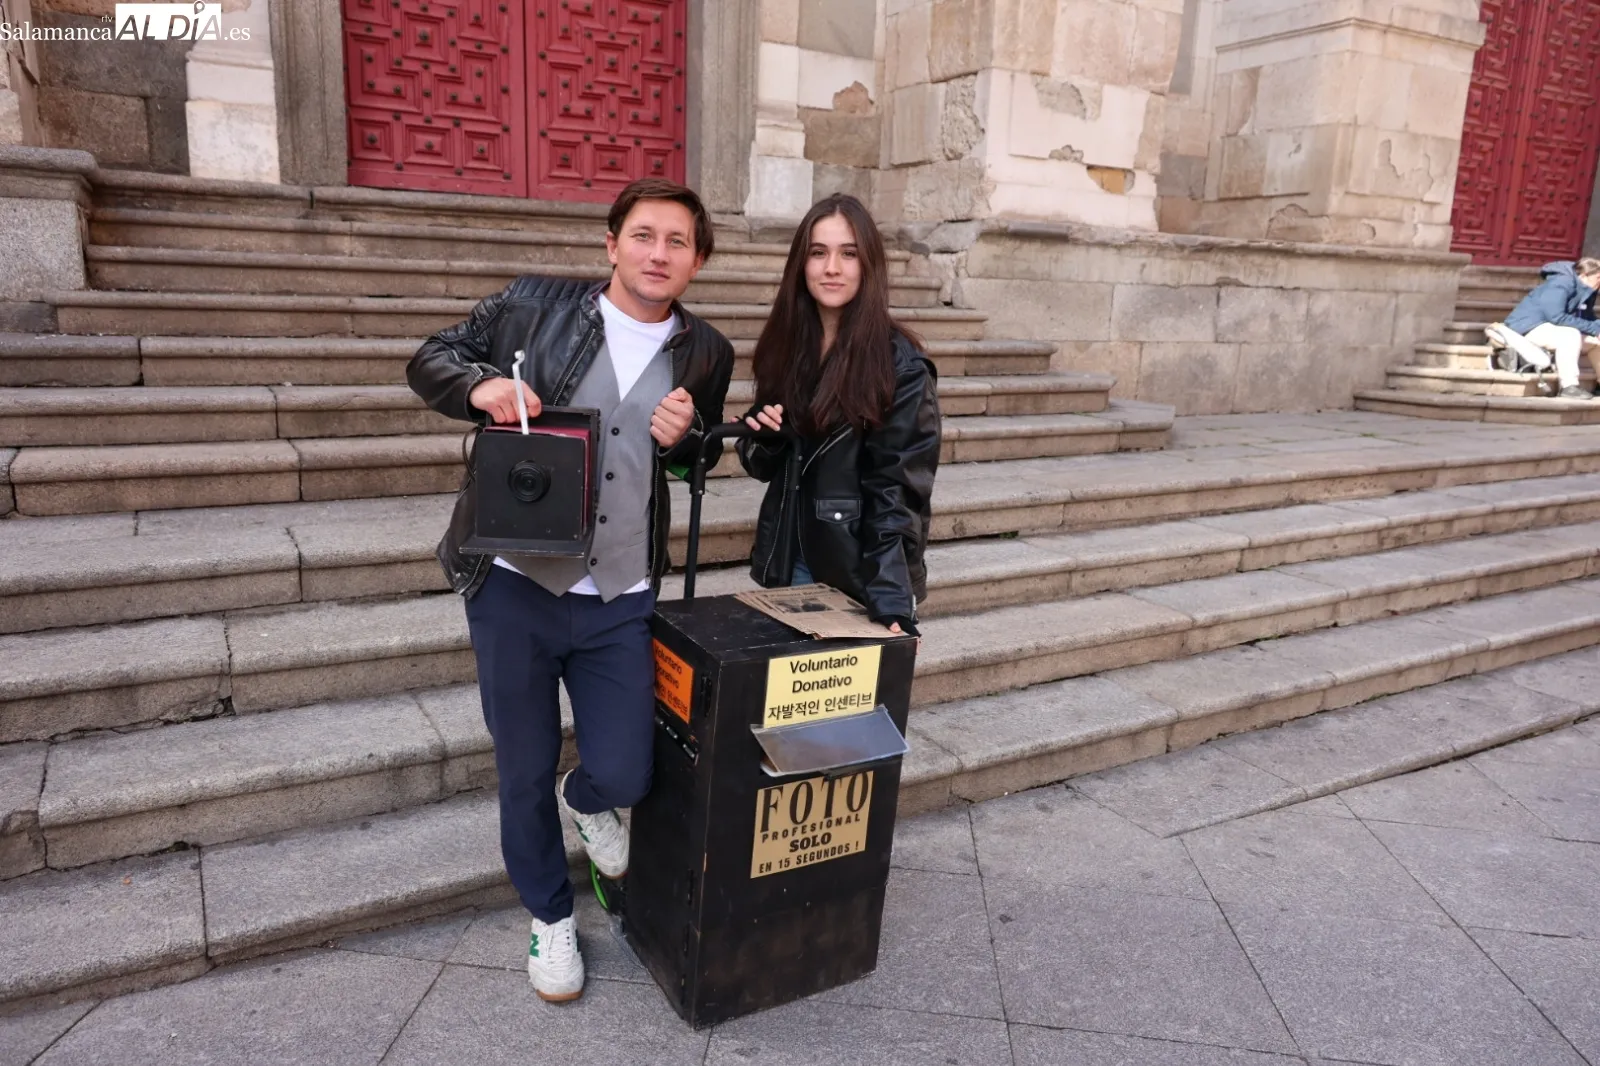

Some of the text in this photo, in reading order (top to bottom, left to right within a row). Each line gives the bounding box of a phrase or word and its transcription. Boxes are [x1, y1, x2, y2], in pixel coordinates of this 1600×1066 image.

[790, 654, 858, 674] Voluntario
[792, 675, 852, 694] Donativo
[767, 692, 872, 720] 자발적인 인센티브
[760, 771, 869, 833] FOTO
[762, 813, 860, 843] PROFESIONAL
[789, 832, 832, 853] SOLO
[759, 862, 772, 874] EN
[778, 857, 790, 869] 15
[796, 843, 850, 865] SEGUNDOS
